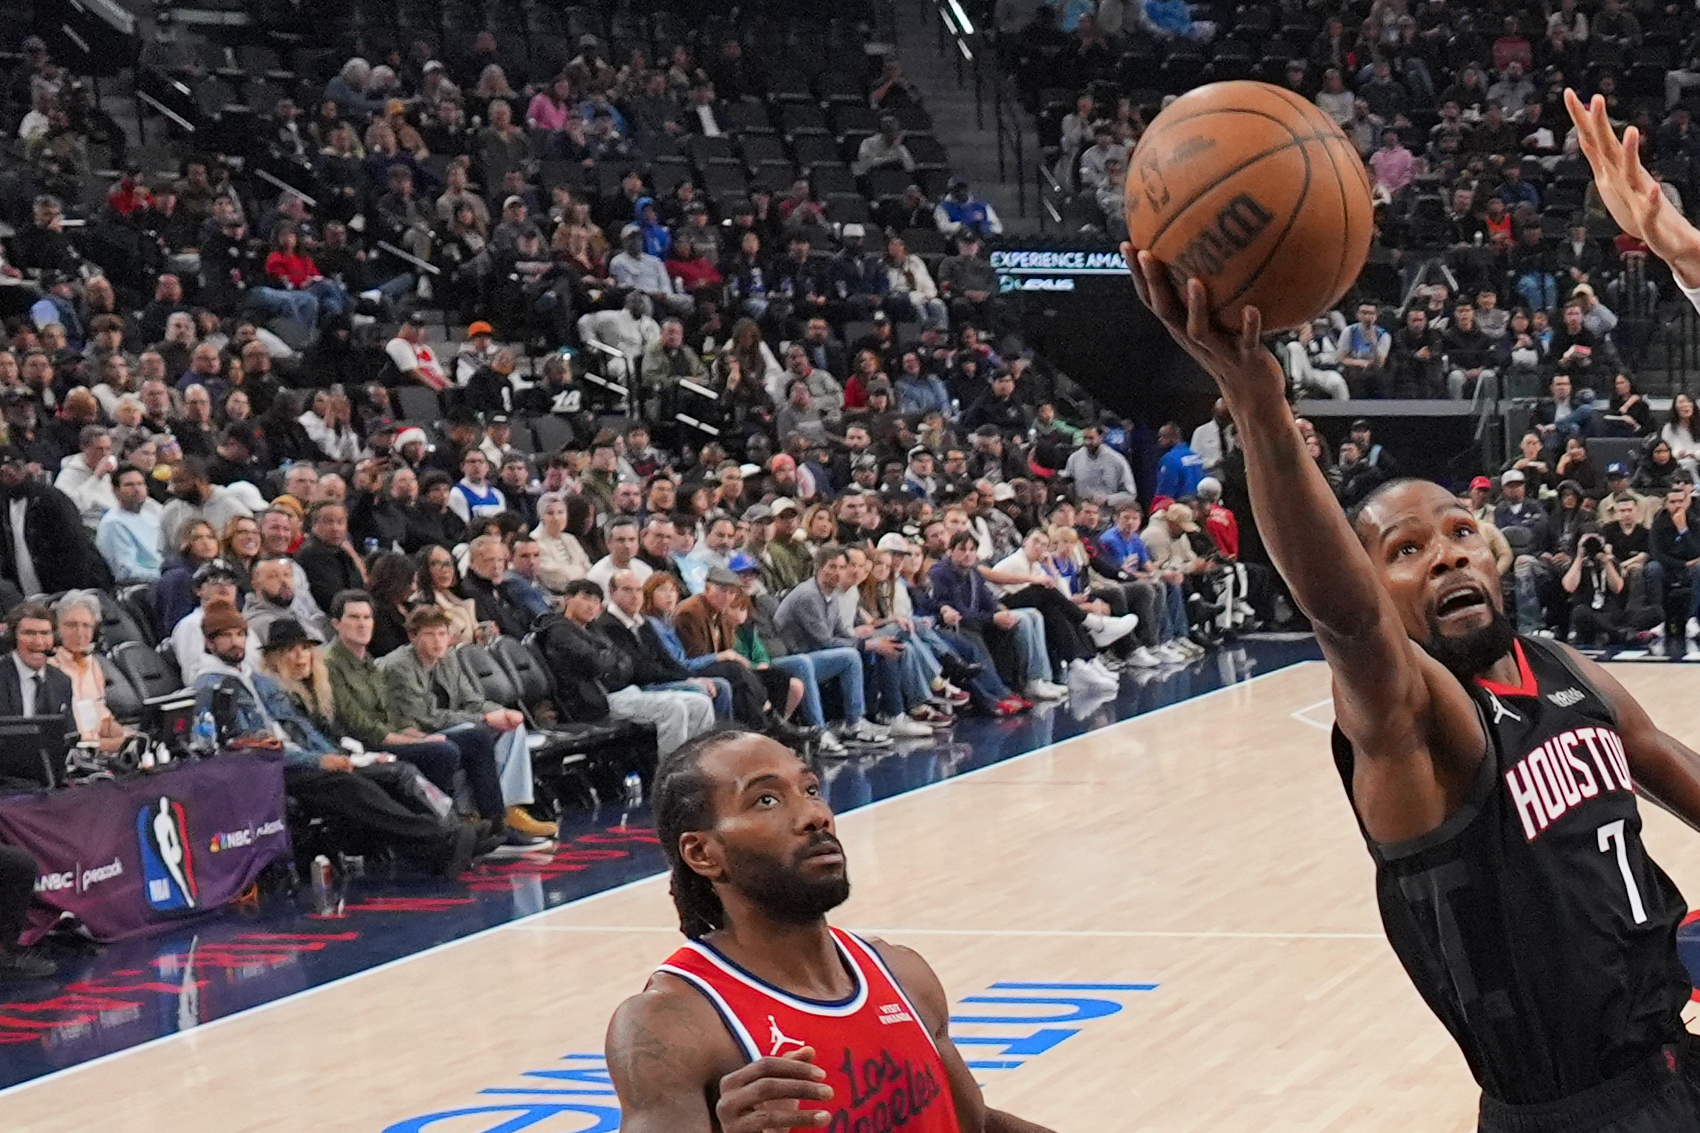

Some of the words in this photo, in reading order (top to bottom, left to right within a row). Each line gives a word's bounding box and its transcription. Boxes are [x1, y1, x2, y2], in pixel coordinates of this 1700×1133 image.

[989, 251, 1085, 268] EXPERIENCE
[1504, 726, 1634, 842] HOUSTO
[1596, 818, 1648, 925] 7
[840, 1047, 902, 1109] Los
